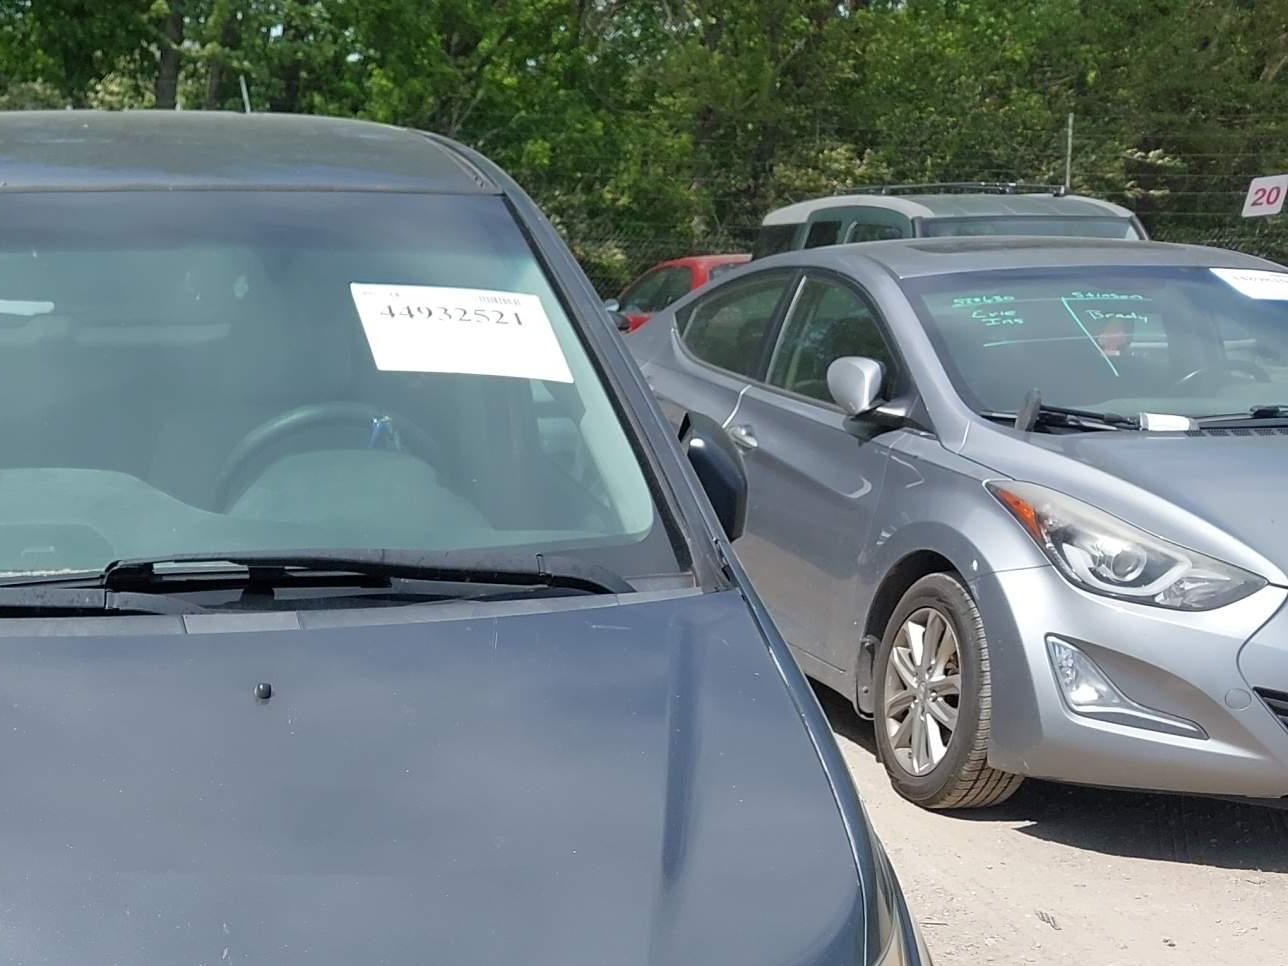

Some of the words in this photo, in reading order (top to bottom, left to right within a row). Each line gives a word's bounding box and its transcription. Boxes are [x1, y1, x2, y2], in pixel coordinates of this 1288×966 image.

[1251, 186, 1281, 207] 20
[380, 304, 524, 327] 44932521
[1085, 309, 1148, 324] Brady
